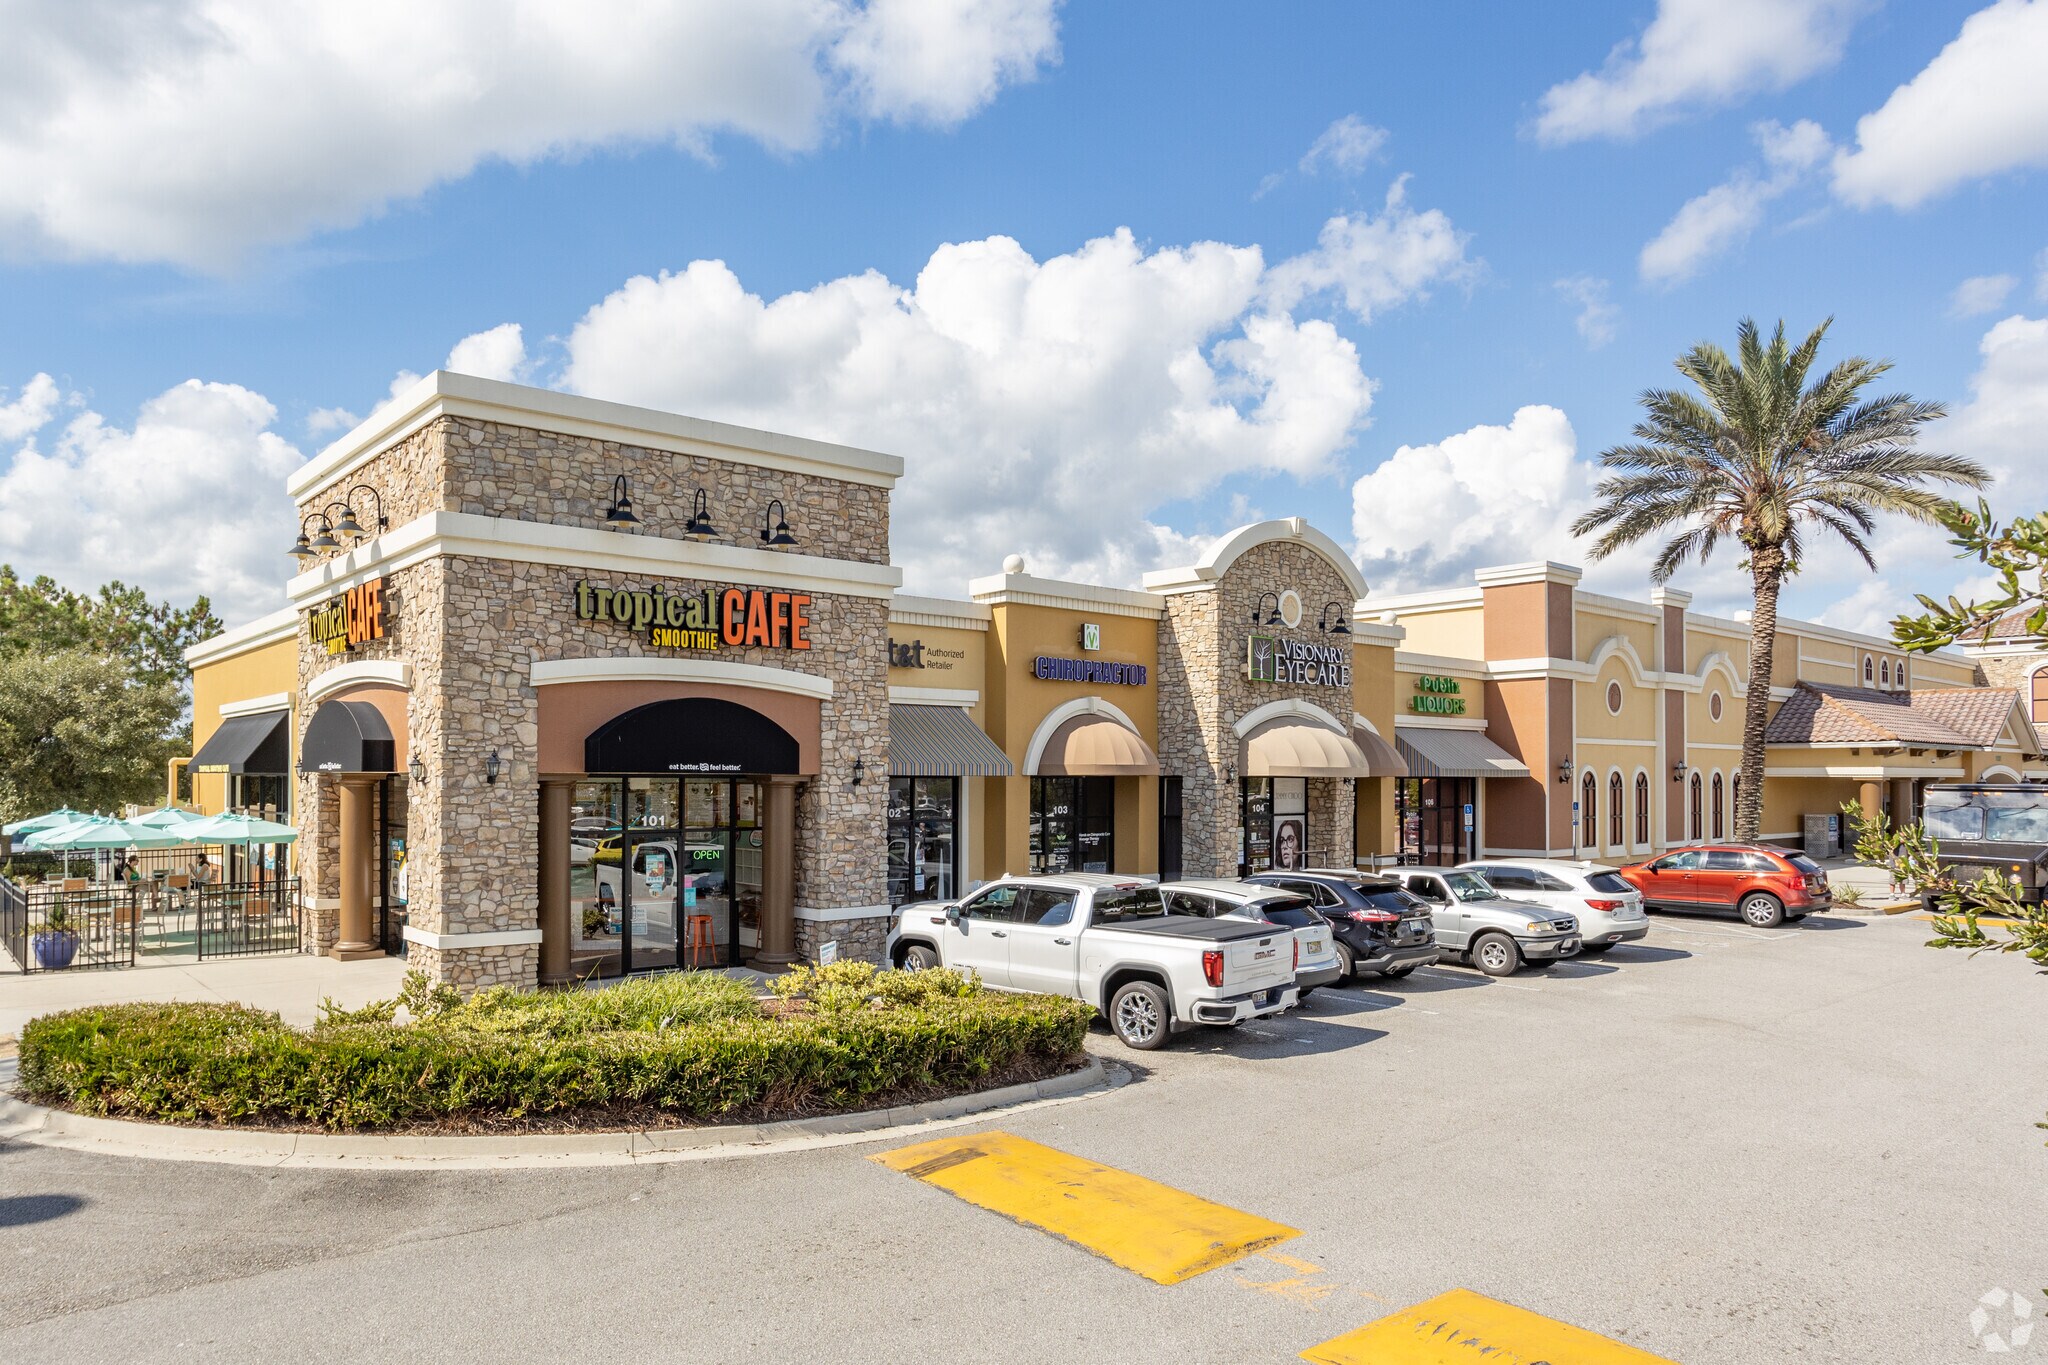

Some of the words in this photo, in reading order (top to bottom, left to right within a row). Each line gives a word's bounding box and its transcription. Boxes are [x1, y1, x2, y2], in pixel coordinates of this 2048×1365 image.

[307, 594, 348, 647] tropical
[347, 577, 384, 646] CAFE
[576, 577, 719, 631] tropical
[722, 588, 812, 650] CAFE
[652, 628, 718, 651] SMOOTHIE
[888, 637, 926, 669] t&t
[926, 647, 965, 659] Authorized
[1282, 638, 1344, 664] VISIONARY
[926, 660, 953, 670] Retailer
[1035, 655, 1148, 686] CHIROPRACTOR
[1274, 653, 1350, 688] EYECARE
[1416, 695, 1466, 715] LIQUORS
[709, 763, 721, 771] feel
[888, 808, 902, 818] 02
[1053, 805, 1068, 815] 103
[1252, 804, 1265, 813] 104
[641, 815, 665, 827] 101
[693, 850, 720, 860] OPEN
[1254, 949, 1276, 960] GMC
